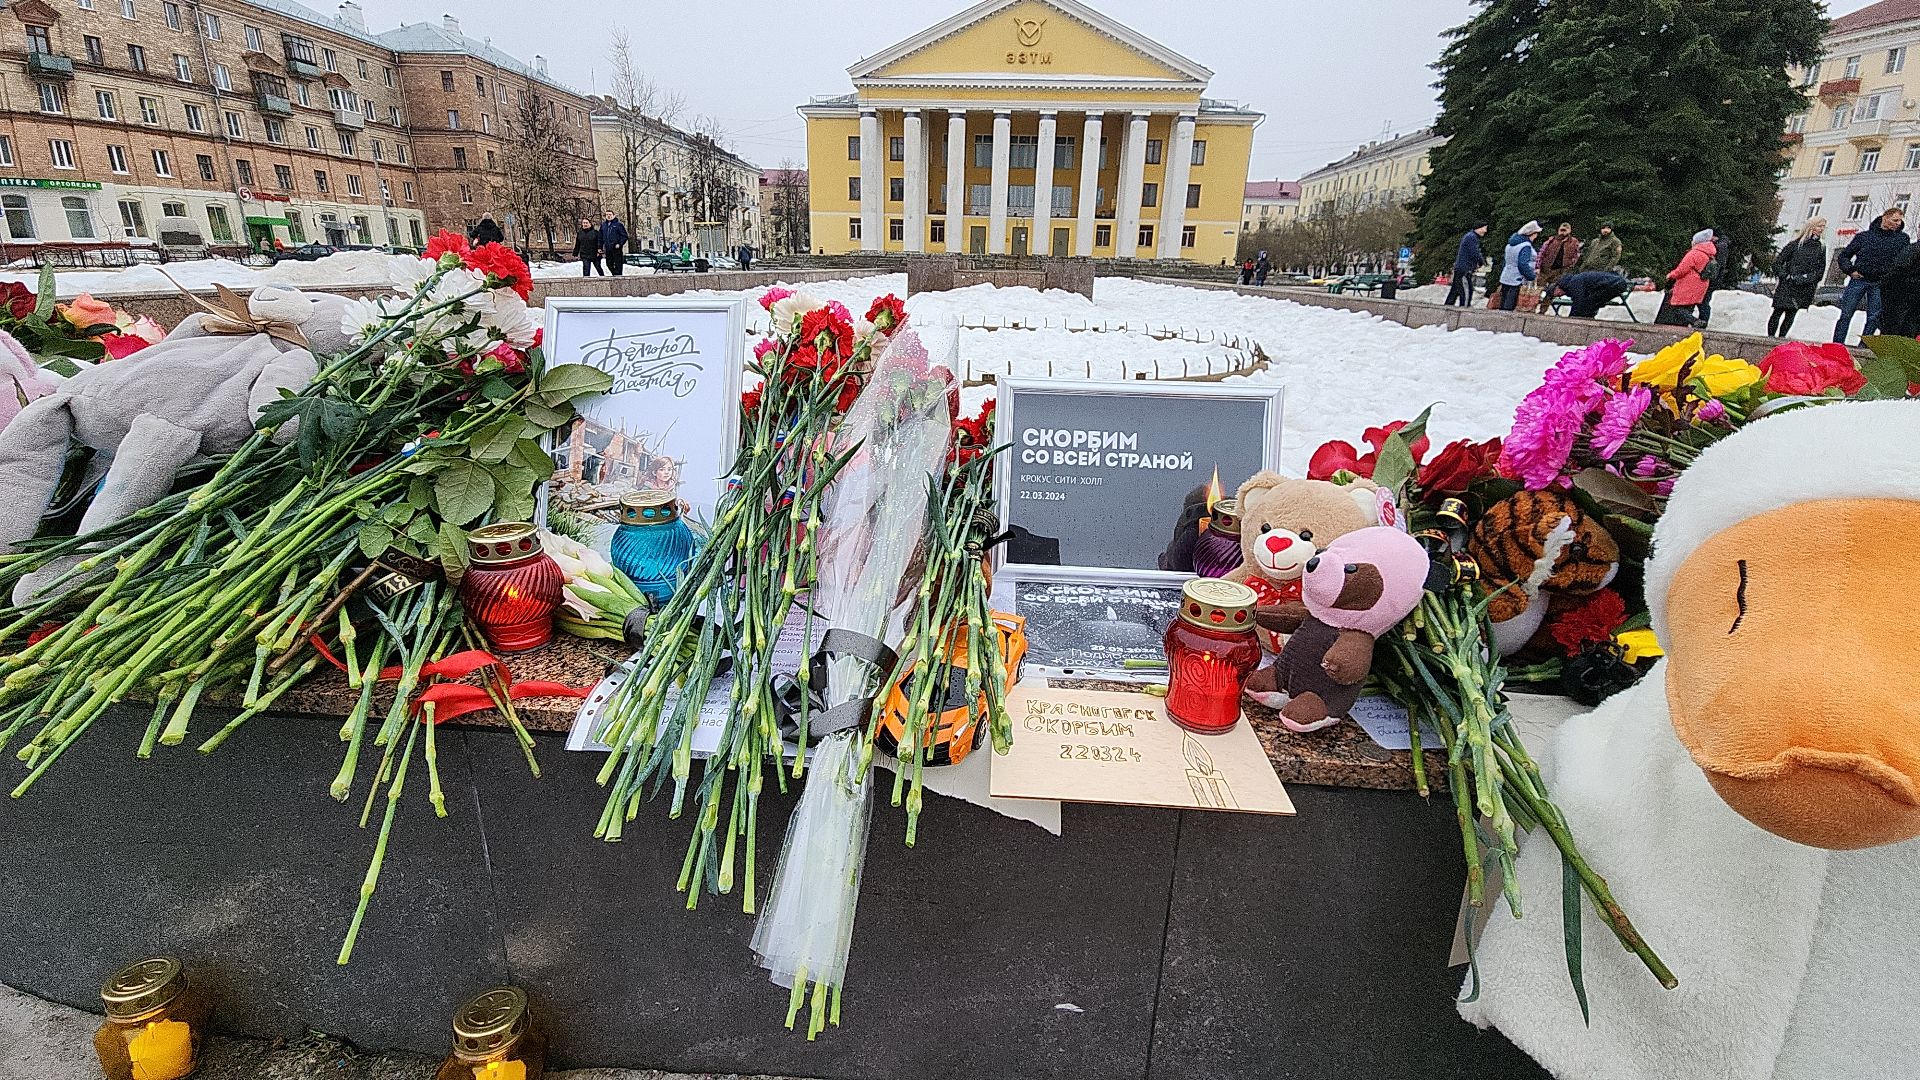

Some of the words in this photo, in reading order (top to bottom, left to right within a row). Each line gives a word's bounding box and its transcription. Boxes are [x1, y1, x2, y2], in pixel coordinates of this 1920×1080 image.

[49, 180, 98, 189] ОРТОПЕДИЯ
[1022, 428, 1138, 450] СКОРБИМ
[1021, 449, 1050, 464] СО
[1053, 447, 1101, 467] ВСЕЙ
[1105, 451, 1193, 471] СТРАНОЙ
[1020, 474, 1051, 484] КРОКУС
[1055, 475, 1077, 485] СИТИ
[1080, 476, 1103, 486] ХОЛЛ
[1020, 490, 1066, 501] 22.03.2024
